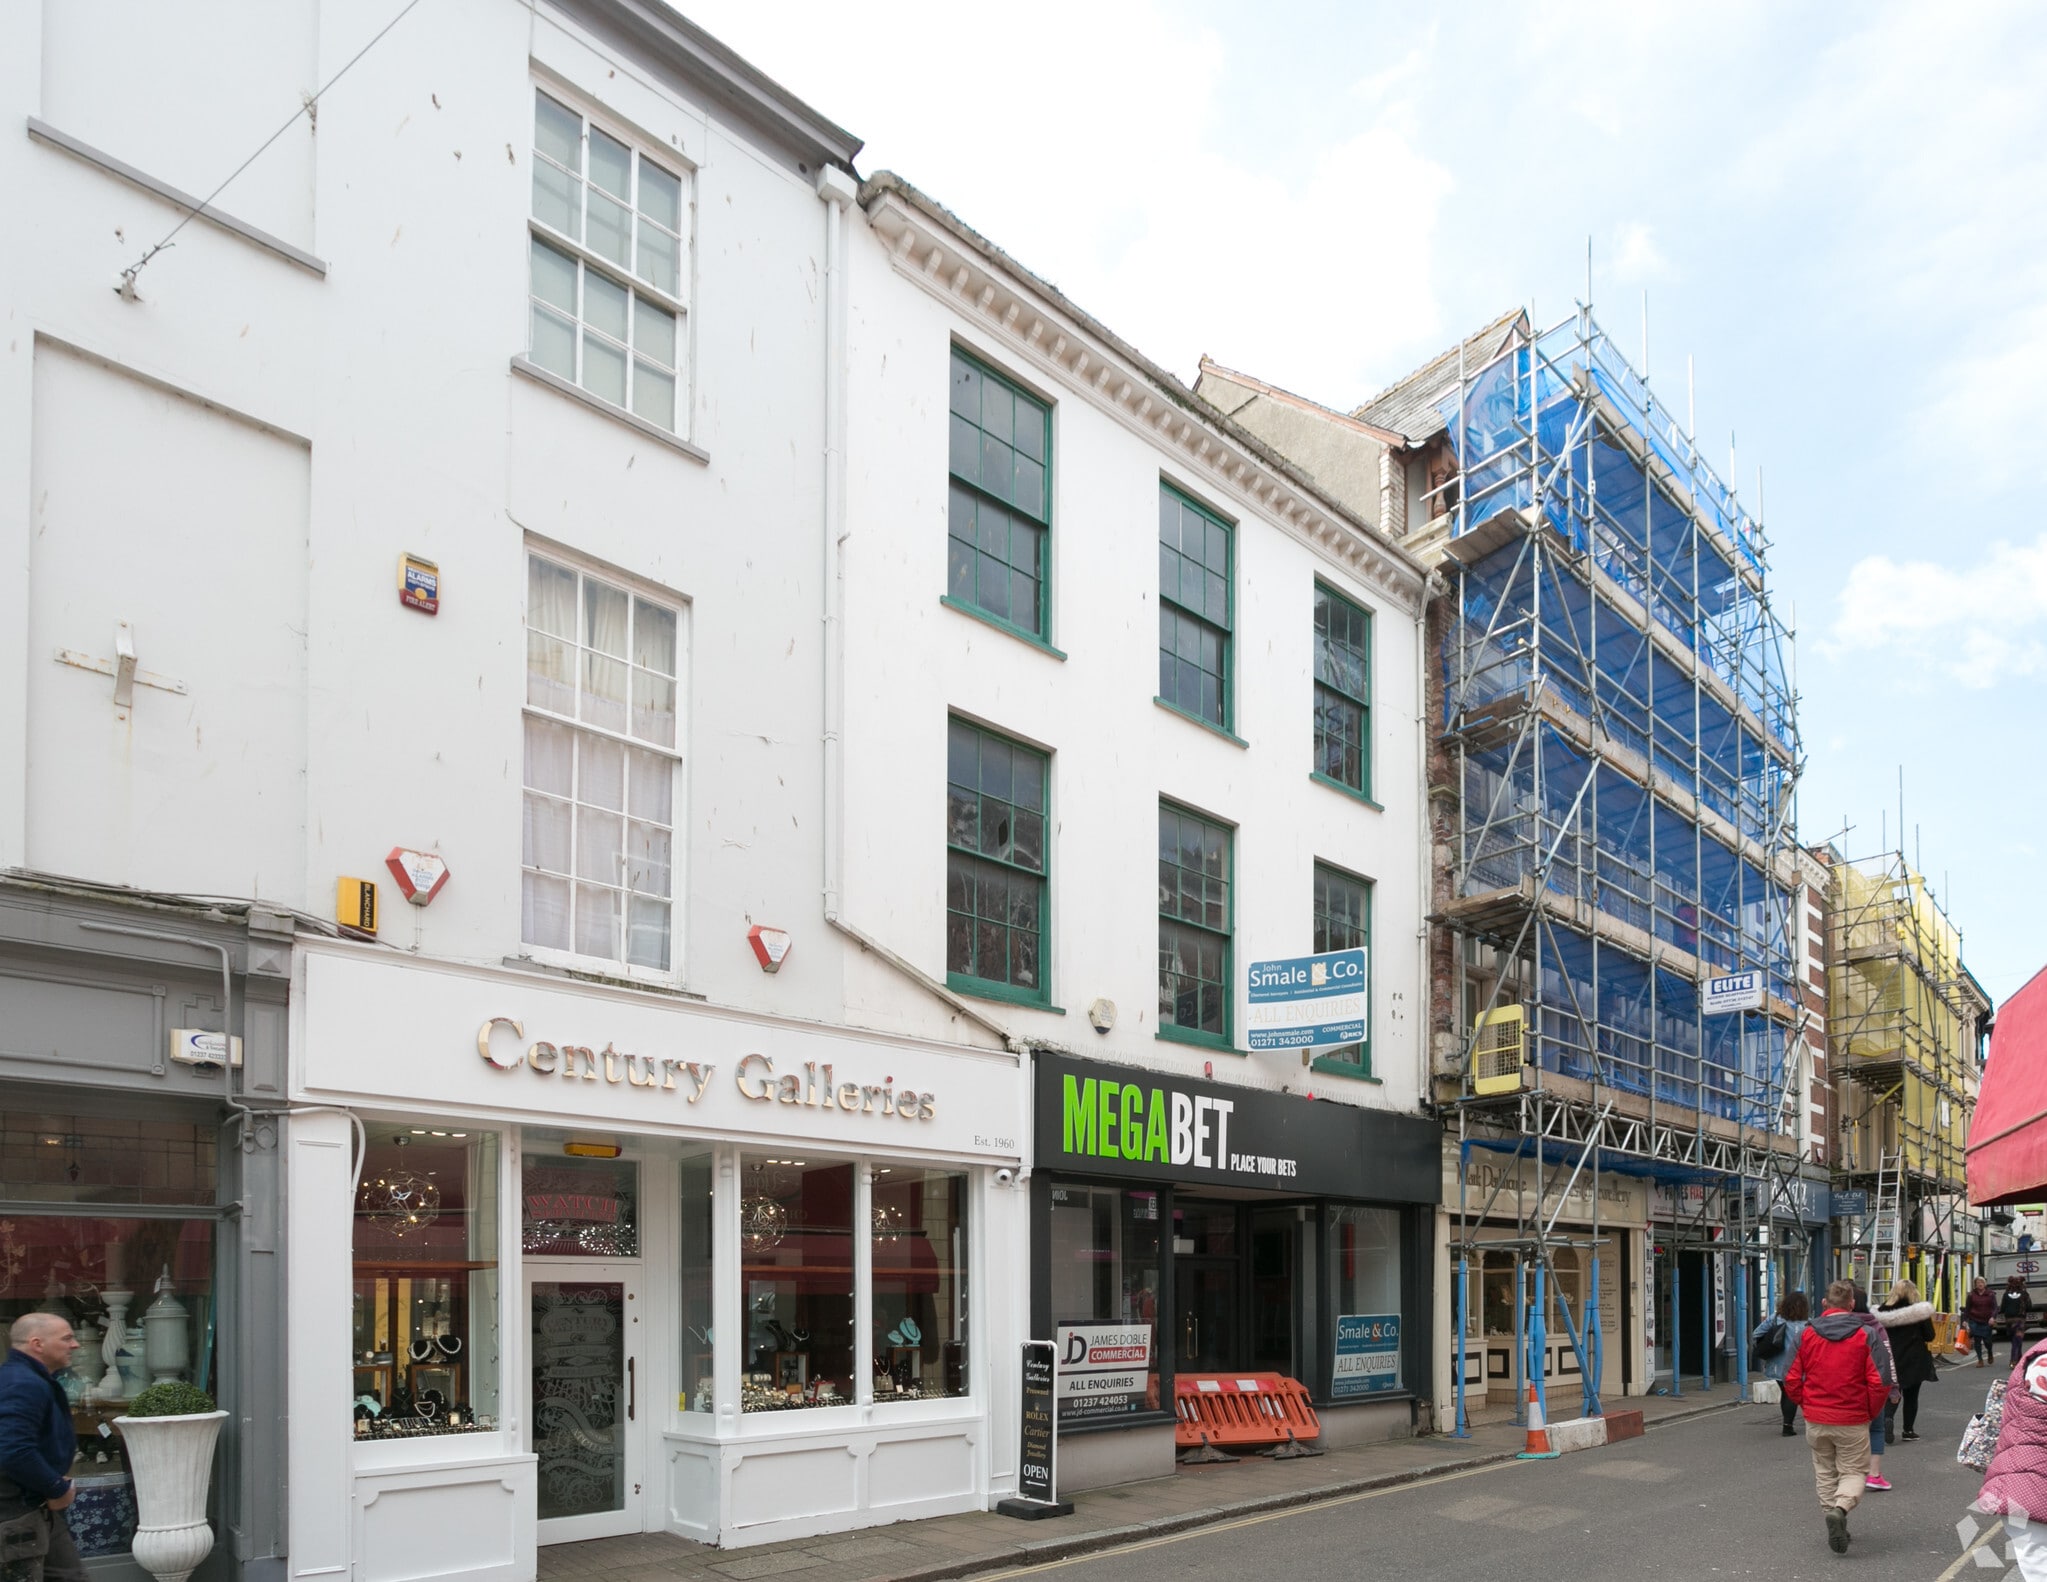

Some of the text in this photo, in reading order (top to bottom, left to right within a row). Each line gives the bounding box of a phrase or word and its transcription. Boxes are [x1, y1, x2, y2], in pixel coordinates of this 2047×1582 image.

[363, 883, 372, 927] BLANCHARD
[1250, 966, 1307, 987] Smale
[1333, 961, 1363, 978] Co.
[1262, 963, 1282, 973] John
[1714, 975, 1751, 992] ELITE
[1253, 997, 1361, 1024] ALL ENQUIRIES
[1250, 1029, 1314, 1038] www.johnsmale.com
[1322, 1023, 1362, 1033] COMMERCIAL
[1250, 1035, 1314, 1047] 01271 342000
[477, 1017, 937, 1121] Century Galleries
[1063, 1073, 1234, 1170] MEGABET
[974, 1135, 1015, 1149] Est. 1960
[1231, 1153, 1297, 1177] PLACE YOUR BETS
[1483, 1165, 1527, 1199] Parkhoue
[528, 1193, 618, 1214] WATCH
[1338, 1323, 1370, 1340] Smale
[1372, 1322, 1383, 1338] &
[1383, 1322, 1399, 1337] Co.
[1090, 1333, 1147, 1346] JAMES DOBLE
[1091, 1348, 1145, 1361] COMMERCIAL
[1025, 1359, 1050, 1372] Century
[1337, 1354, 1397, 1373] ALL ENQUIRIES
[1069, 1376, 1134, 1391] ALL ENQUIRIES
[1073, 1395, 1128, 1408] 01237 424053
[1025, 1410, 1049, 1421] ROLEX
[1061, 1404, 1129, 1417] www.jd-commercial.co.uk
[1024, 1424, 1051, 1438] Cartier
[1023, 1463, 1049, 1480] OPEN
